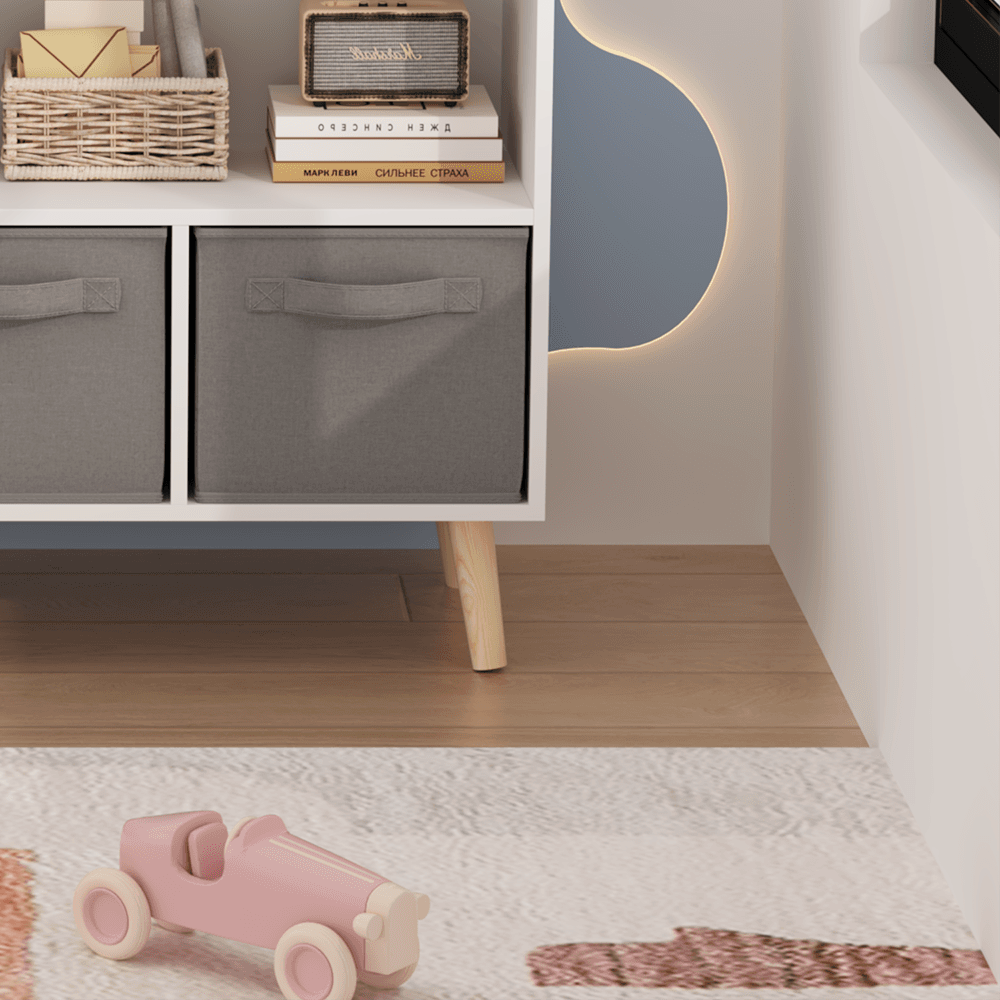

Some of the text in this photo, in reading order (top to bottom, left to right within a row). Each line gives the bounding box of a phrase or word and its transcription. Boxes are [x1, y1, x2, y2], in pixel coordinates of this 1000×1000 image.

[303, 168, 469, 178] МАРК ЛЕВИ СИЛЬНЕЕ СТРАХА
